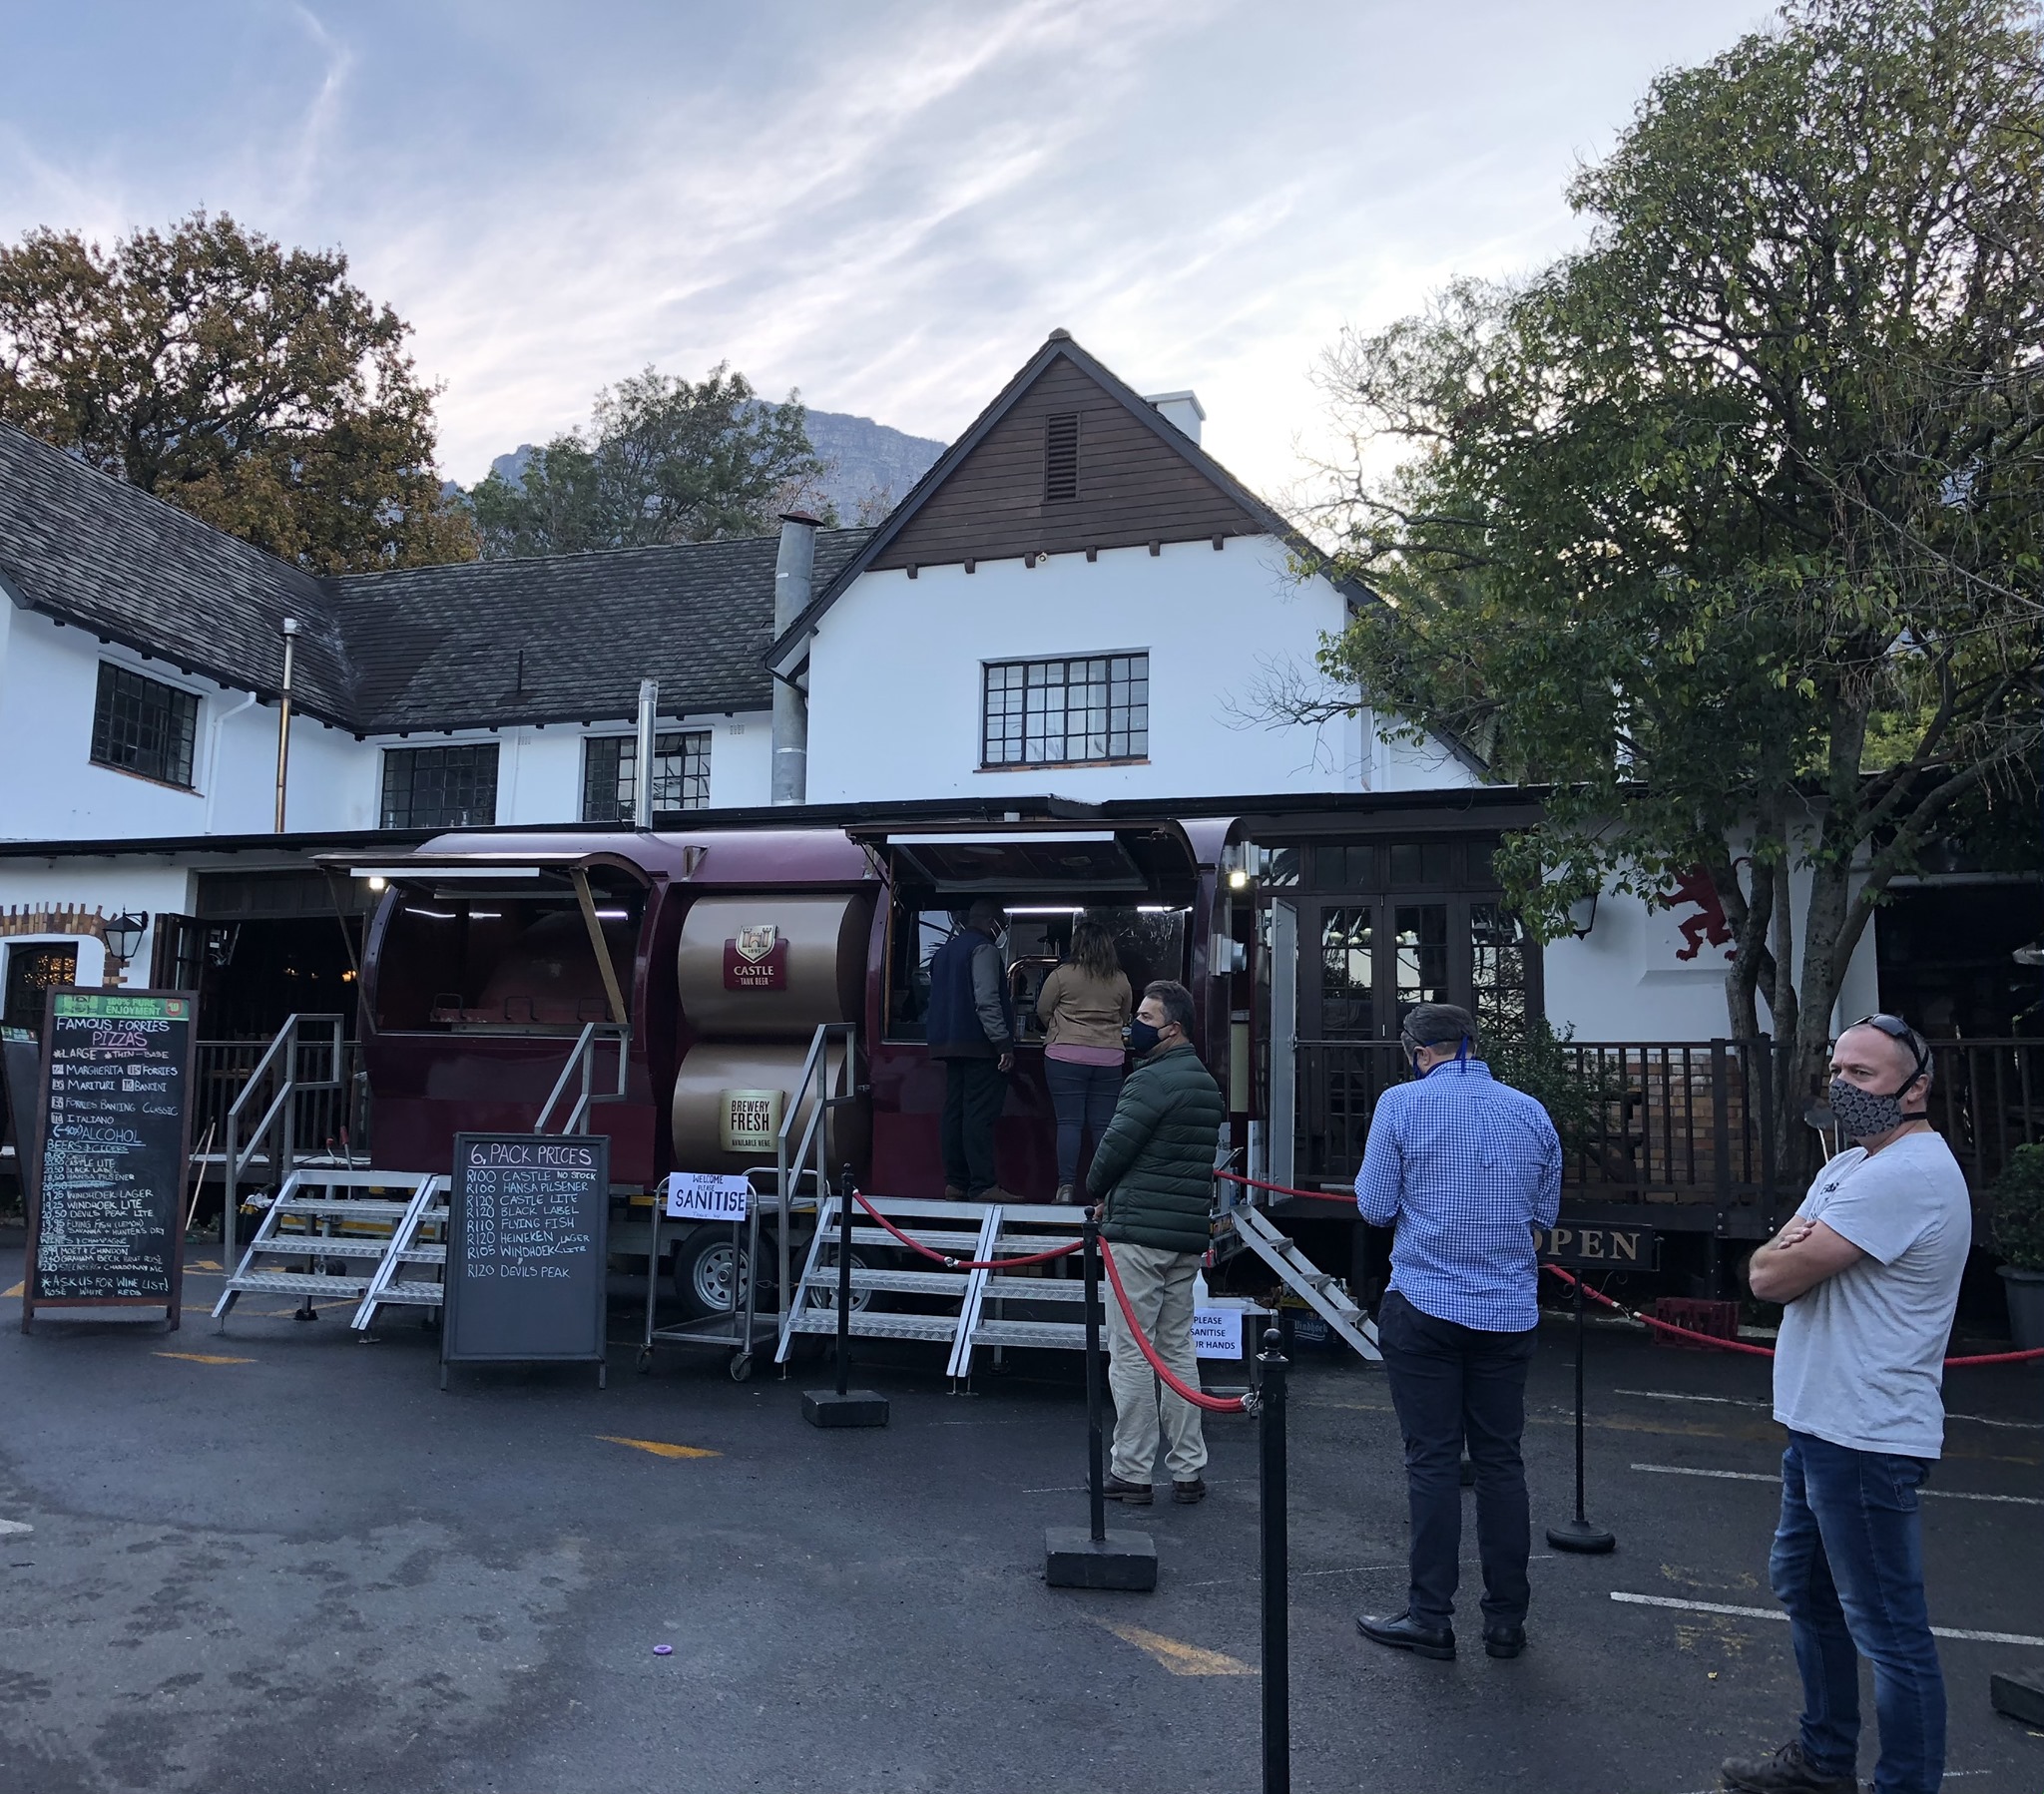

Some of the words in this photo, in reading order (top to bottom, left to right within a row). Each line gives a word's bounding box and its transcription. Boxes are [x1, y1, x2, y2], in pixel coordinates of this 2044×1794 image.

[734, 966, 774, 976] CASTLE
[741, 977, 755, 986] TANK
[755, 977, 769, 986] BEER
[133, 998, 156, 1008] PURE
[105, 1006, 161, 1016] ENJOYMENT
[56, 1017, 113, 1032] FAMOUS
[118, 1020, 171, 1033] FORRIES
[92, 1031, 148, 1047] PIZZAS
[62, 1048, 98, 1061] LARGE
[144, 1051, 169, 1060] BASE
[66, 1064, 124, 1076] MARGHERITA
[142, 1065, 179, 1077] FORRIES
[67, 1079, 116, 1092] MARITURI
[100, 1100, 136, 1113] BANTING
[142, 1102, 179, 1117] CLASSIC
[731, 1100, 770, 1113] BREWERY
[67, 1114, 115, 1124] ITALIANO
[731, 1113, 769, 1130] FRESH
[81, 1127, 143, 1143] ALCOHOL
[47, 1138, 82, 1151] BEERS
[490, 1142, 532, 1164] PACK
[538, 1144, 592, 1165] PRICES
[65, 1158, 95, 1167] CASTLE
[97, 1158, 115, 1168] LITE
[466, 1169, 497, 1183] R100
[502, 1170, 552, 1182] CASTLE
[557, 1170, 569, 1179] NO
[570, 1170, 597, 1181] STOCK
[693, 1174, 724, 1184] WELCOME
[66, 1190, 118, 1200] WINDHOEK
[119, 1188, 154, 1198] LAGER
[466, 1183, 496, 1194] R100
[503, 1181, 539, 1193] HANSA
[540, 1181, 589, 1193] PILSENER
[42, 1202, 65, 1211] 19,25
[67, 1200, 118, 1210] WINDHOEK
[120, 1198, 143, 1210] LITE
[466, 1194, 495, 1208] R120
[499, 1194, 544, 1206] CASTLE
[550, 1193, 579, 1203] LITE
[675, 1188, 747, 1212] SANITISE
[41, 1210, 68, 1220] 20,50
[70, 1209, 101, 1218] DEVILS
[466, 1205, 495, 1218] R120
[500, 1206, 538, 1217] BLACK
[543, 1205, 579, 1215] LABEL
[94, 1218, 112, 1228] FISH
[466, 1219, 495, 1233] R110
[501, 1218, 541, 1229] FLYING
[544, 1216, 576, 1229] FISH
[40, 1235, 74, 1244] WINES
[466, 1231, 496, 1245] R120
[500, 1230, 554, 1244] HEINEKEN
[560, 1233, 591, 1244] LAGER
[89, 1247, 129, 1256] CHANDON
[467, 1244, 496, 1260] R105
[500, 1244, 555, 1258] WINDHOEK
[467, 1263, 495, 1278] R120
[500, 1264, 538, 1278] DEVILS
[541, 1265, 571, 1278] PEAK
[78, 1276, 94, 1285] US
[95, 1277, 114, 1288] FOR
[116, 1276, 139, 1288] WINE
[142, 1277, 170, 1292] LIST!
[1193, 1316, 1223, 1325] PLEASE
[1190, 1328, 1227, 1337] SANITISE
[1206, 1341, 1236, 1350] HANDS
